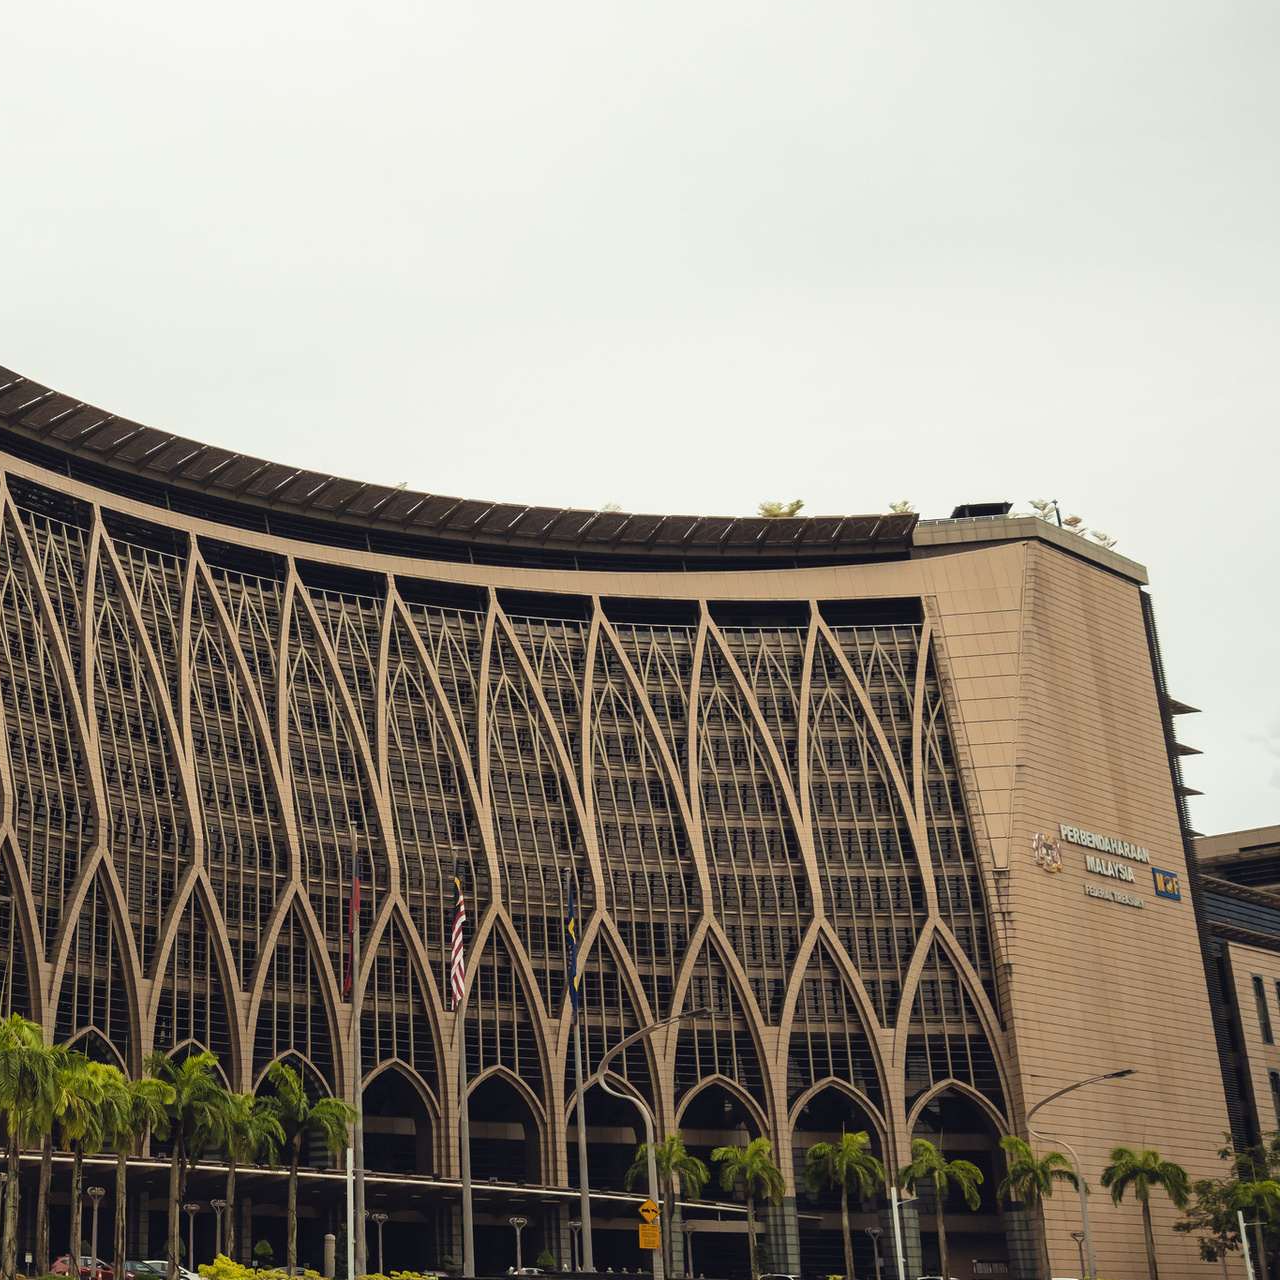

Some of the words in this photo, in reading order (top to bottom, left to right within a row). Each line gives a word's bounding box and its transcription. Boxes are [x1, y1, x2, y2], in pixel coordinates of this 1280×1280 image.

[1059, 824, 1151, 864] PERBENDAHARAAN
[1085, 855, 1135, 883] MALAYSIA
[1084, 884, 1113, 902] FEDERAL
[1113, 891, 1145, 908] TREASURY
